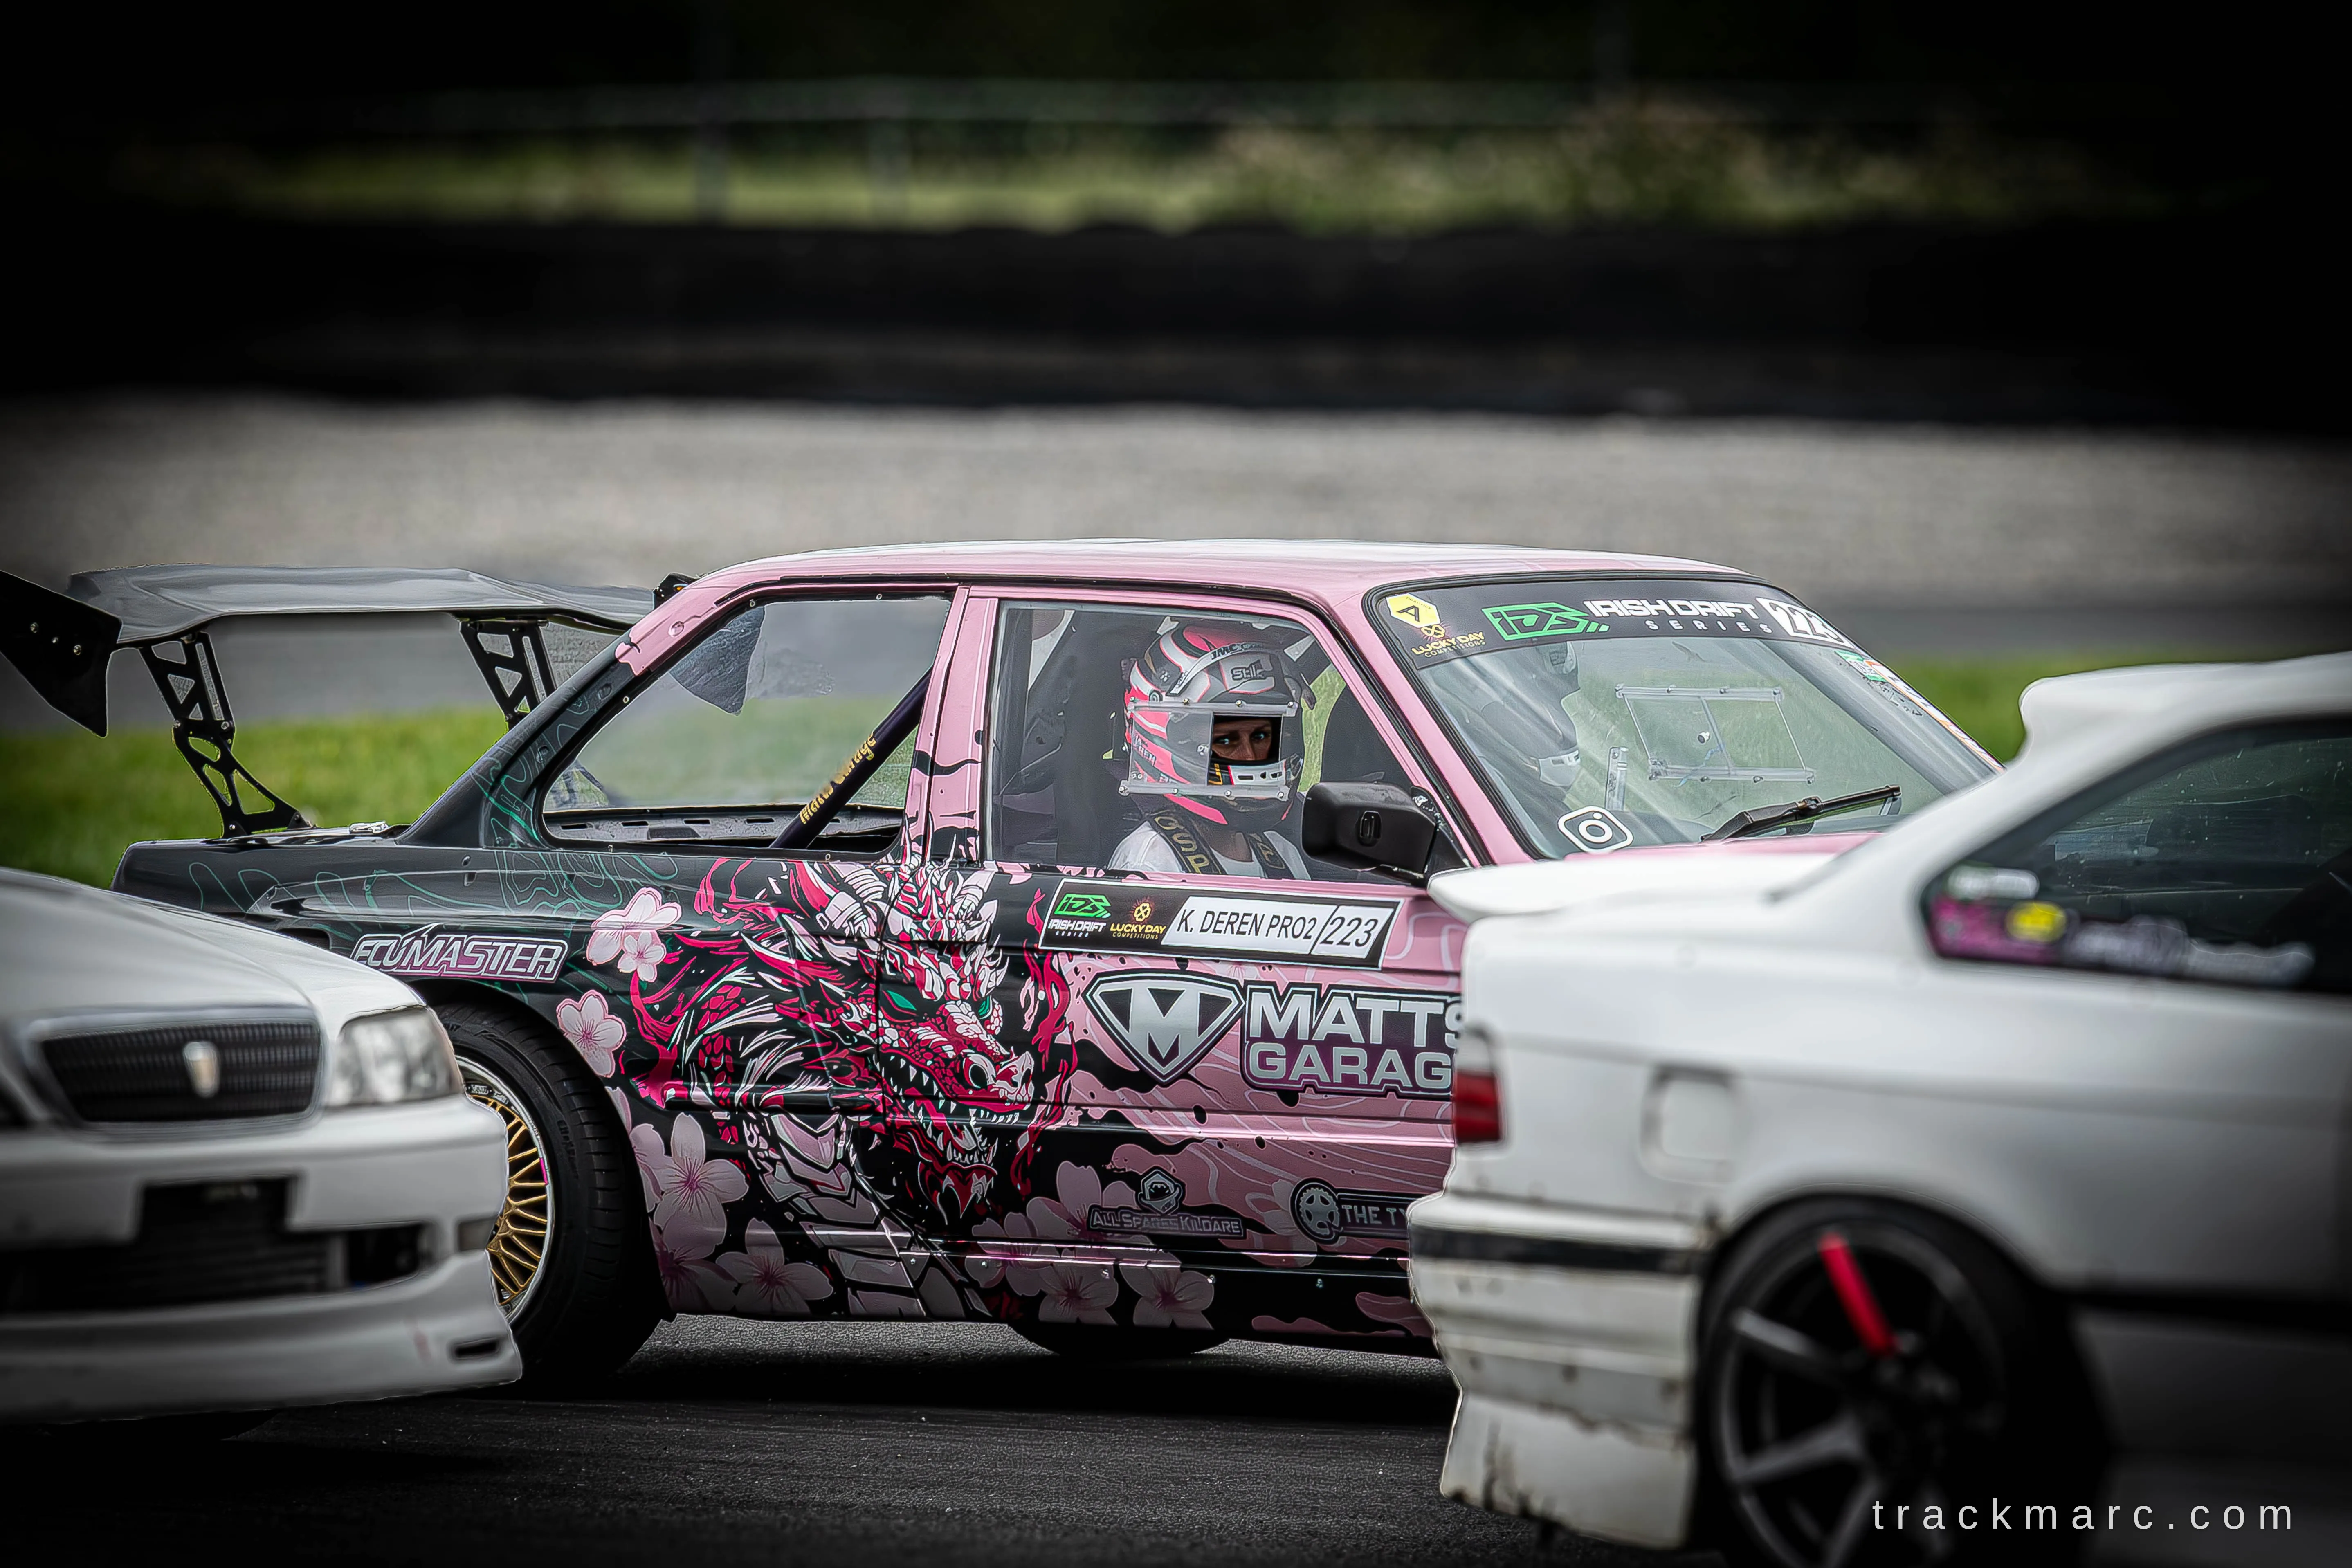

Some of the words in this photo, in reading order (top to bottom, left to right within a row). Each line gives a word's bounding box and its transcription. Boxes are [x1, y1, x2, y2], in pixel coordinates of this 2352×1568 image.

[1396, 605, 1420, 622] A
[1644, 620, 1773, 634] SERIES
[1110, 923, 1145, 933] LUCKY
[1144, 924, 1166, 934] DAY
[1112, 932, 1159, 940] COMPETITIONS
[1177, 909, 1196, 932] K.
[1199, 910, 1265, 937] DEREN
[1265, 914, 1318, 940] PRO2
[1319, 916, 1379, 948] 223
[353, 937, 560, 975] ECUMASTER
[1249, 1042, 1452, 1089] GARAG
[1341, 1204, 1382, 1224] THE
[1180, 1216, 1241, 1233] KILDARE
